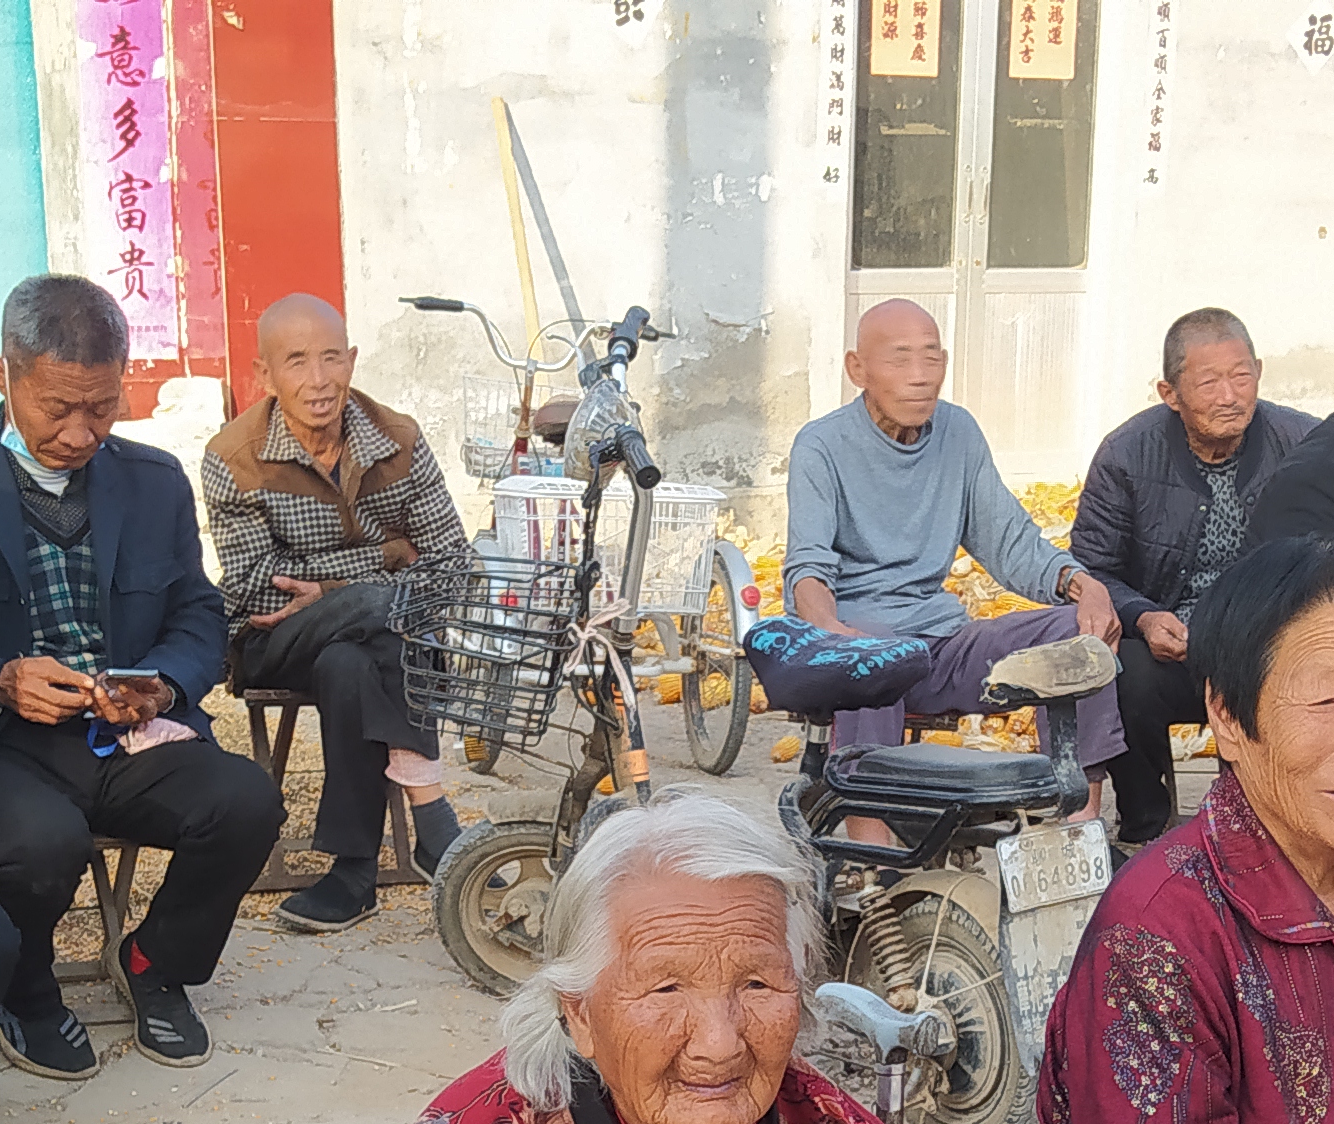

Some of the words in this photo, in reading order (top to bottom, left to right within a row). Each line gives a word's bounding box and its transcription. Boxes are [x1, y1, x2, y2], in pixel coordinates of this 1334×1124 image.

[1019, 0, 1036, 63] 春大吉
[1303, 14, 1334, 57] 福
[95, 0, 156, 301] 意多富贵
